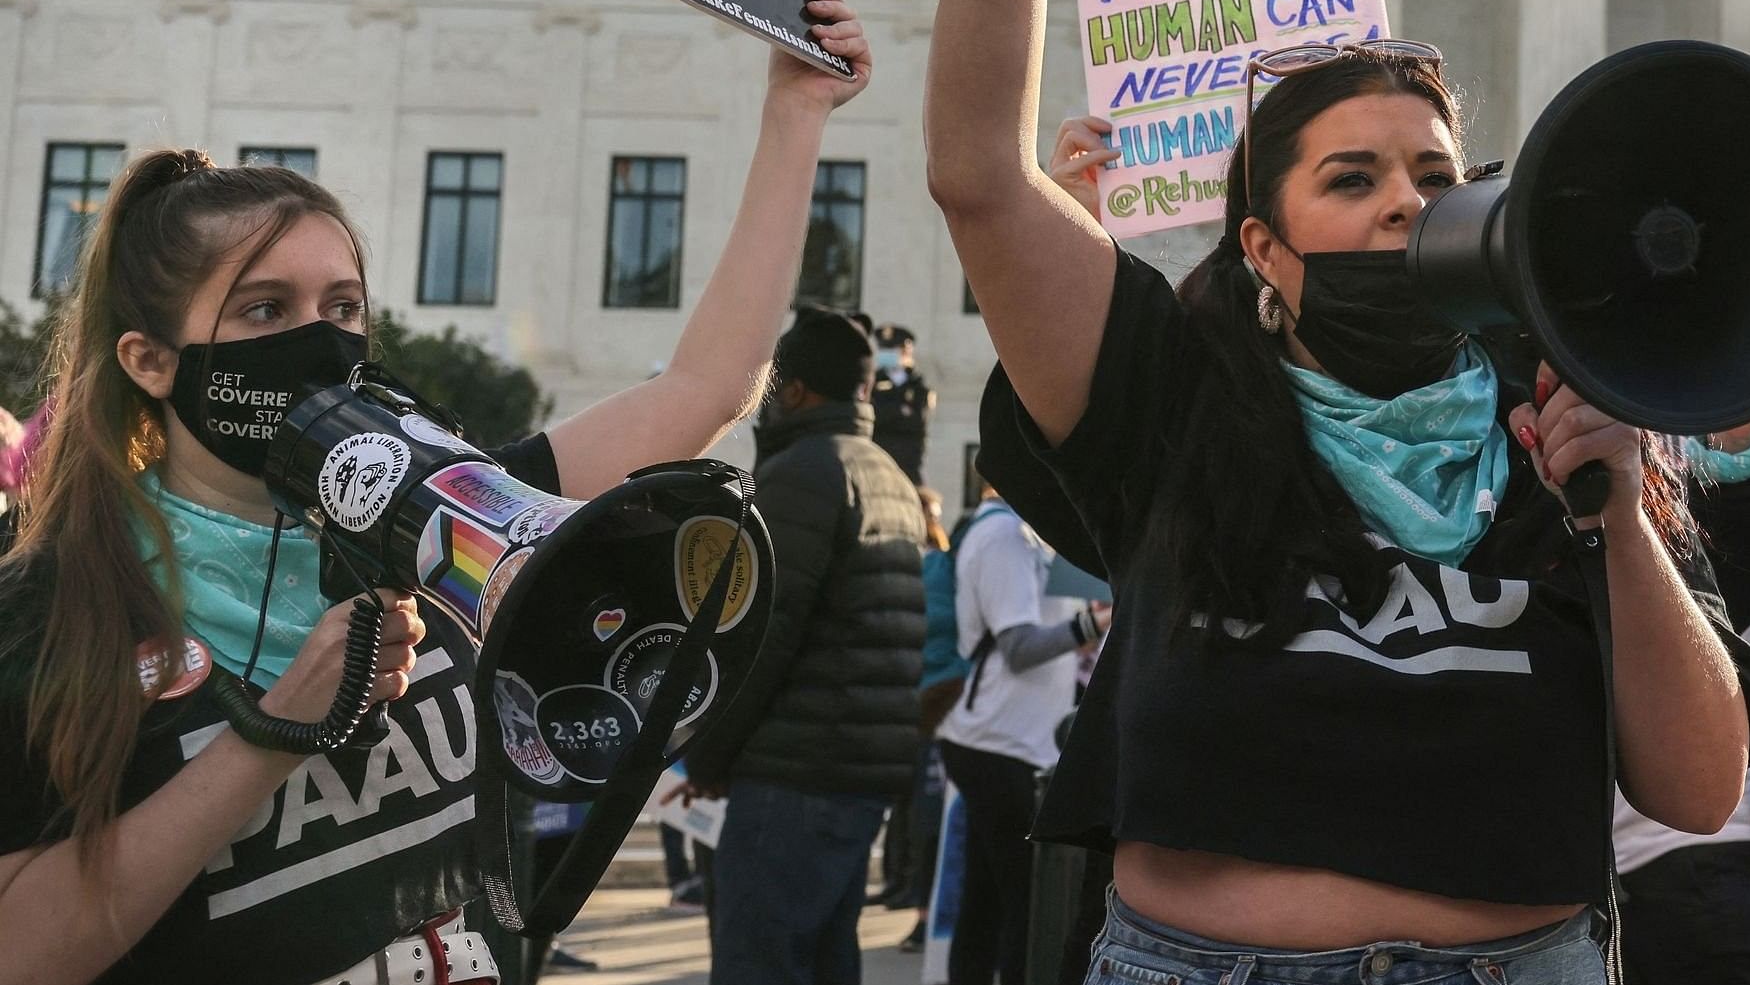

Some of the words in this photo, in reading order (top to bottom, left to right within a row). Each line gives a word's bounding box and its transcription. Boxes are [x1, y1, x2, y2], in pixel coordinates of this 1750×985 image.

[211, 371, 245, 387] GET
[207, 385, 293, 407] COVERE
[206, 418, 278, 440] COVER
[329, 436, 374, 464] ANIMAL
[376, 437, 404, 483] LIBERATION
[321, 475, 339, 518] HUMAN
[341, 493, 387, 527] LIBERATION
[636, 634, 672, 651] DEATH
[616, 652, 635, 696] PENALTY
[550, 717, 621, 743] 2,363
